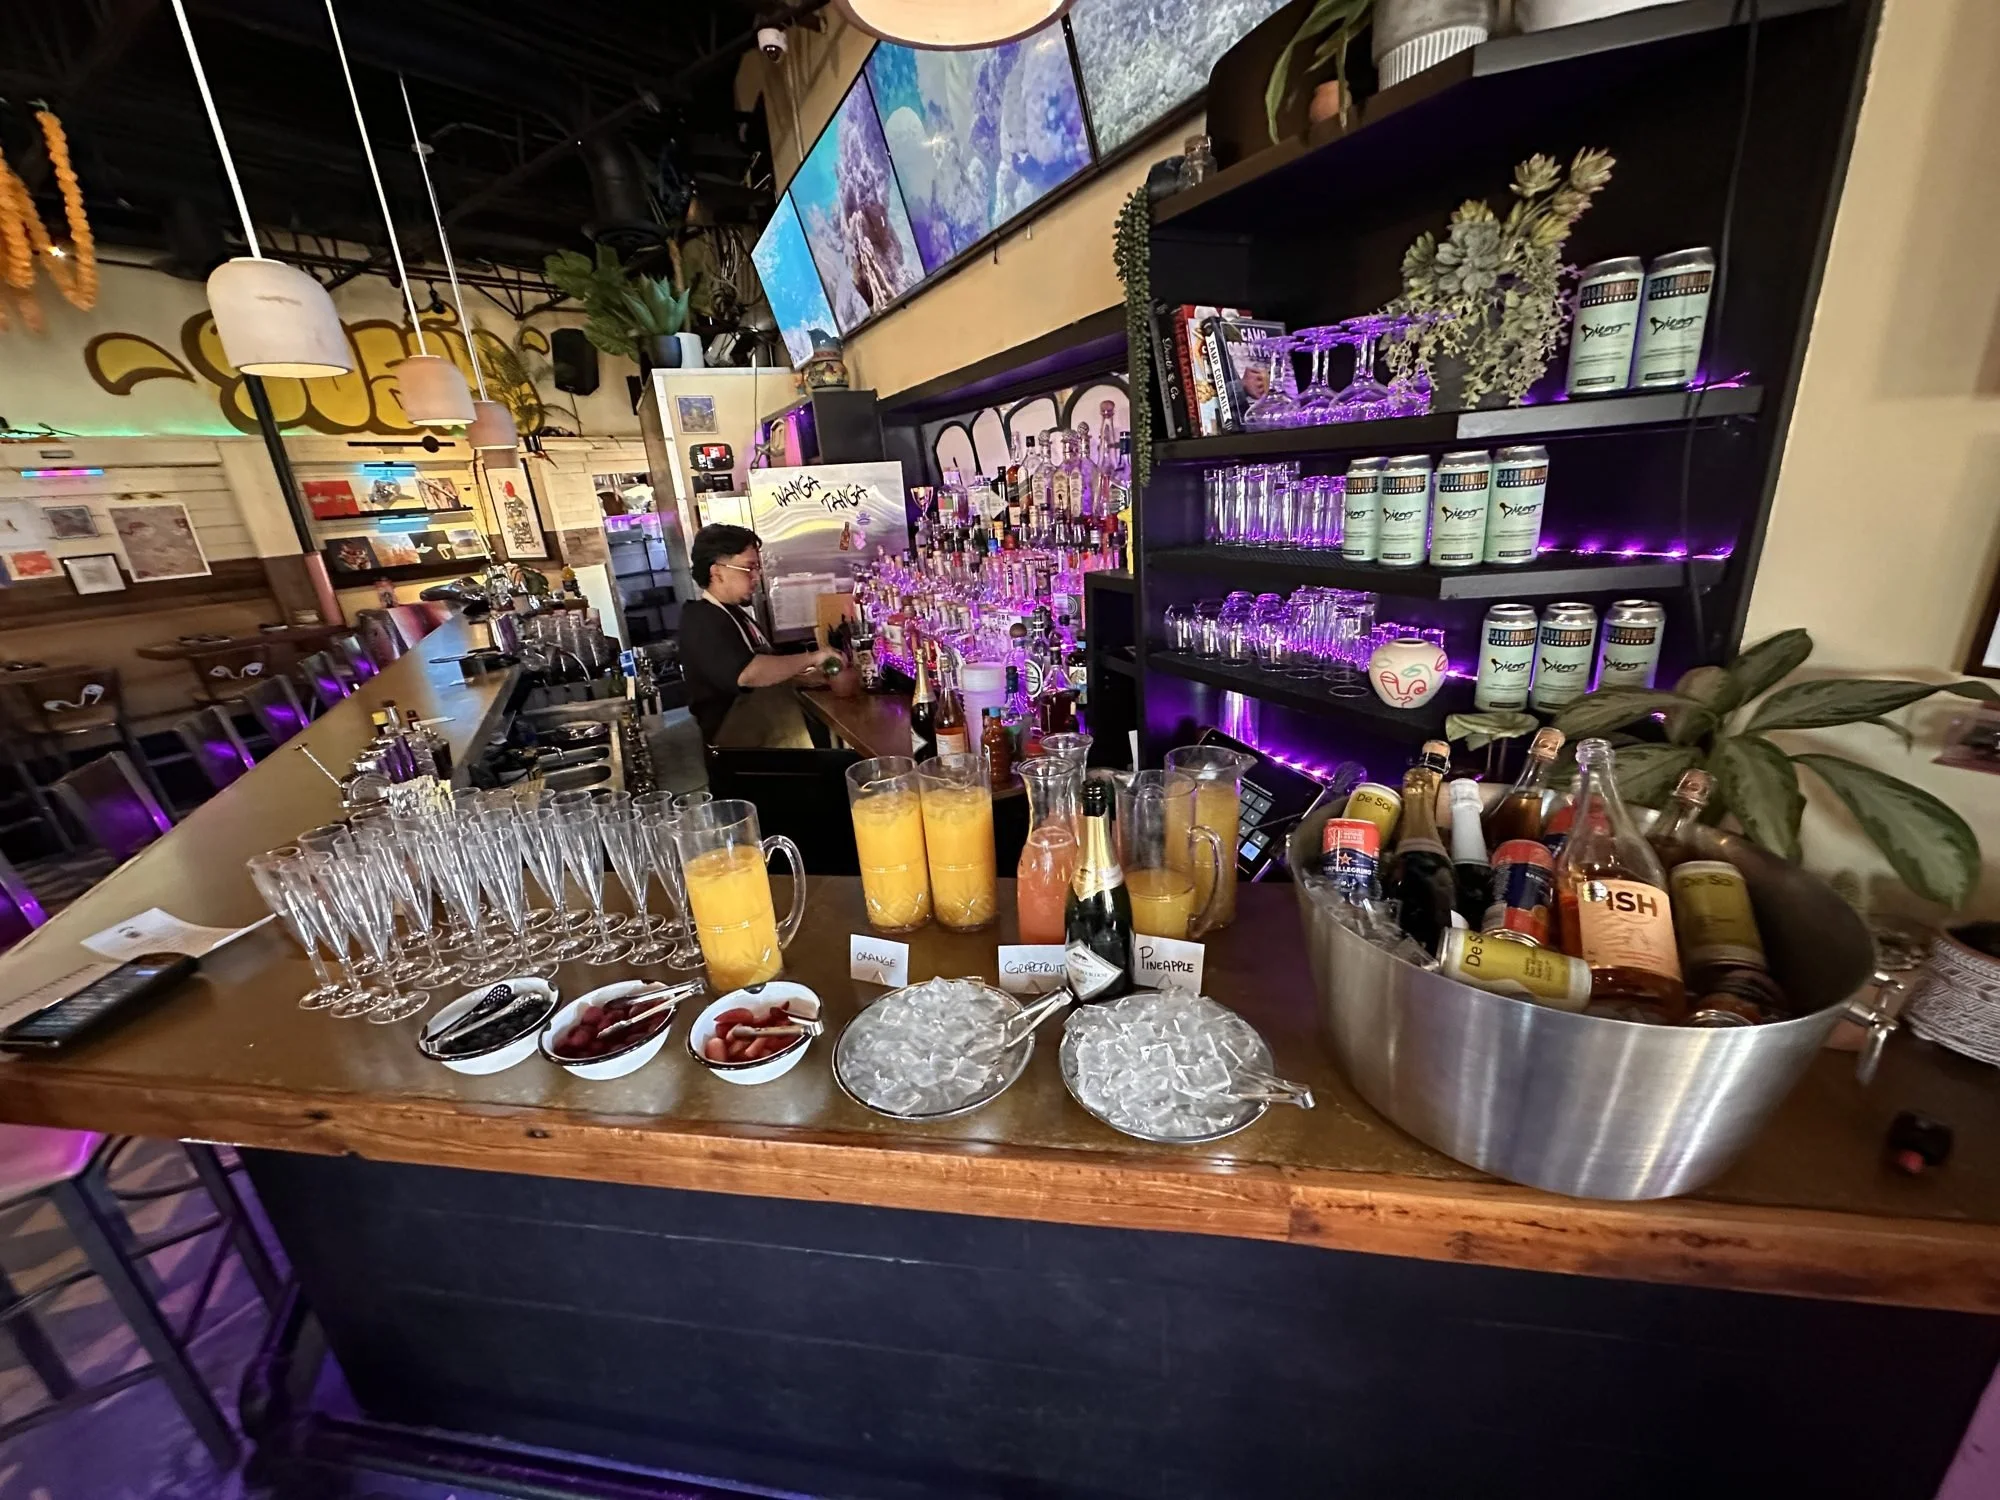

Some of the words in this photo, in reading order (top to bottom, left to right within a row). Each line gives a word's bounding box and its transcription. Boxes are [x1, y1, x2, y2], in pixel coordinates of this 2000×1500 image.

[1208, 340, 1219, 366] CAMP
[1214, 368, 1230, 415] COCKTAILS
[772, 475, 821, 507] WANGA
[821, 484, 869, 512] TANGA
[1356, 793, 1373, 803] De
[856, 951, 897, 969] ORANGE
[1004, 960, 1066, 975] GRAPEFRUIT
[1139, 945, 1195, 973] PINEAPPLE
[1466, 947, 1483, 968] De
